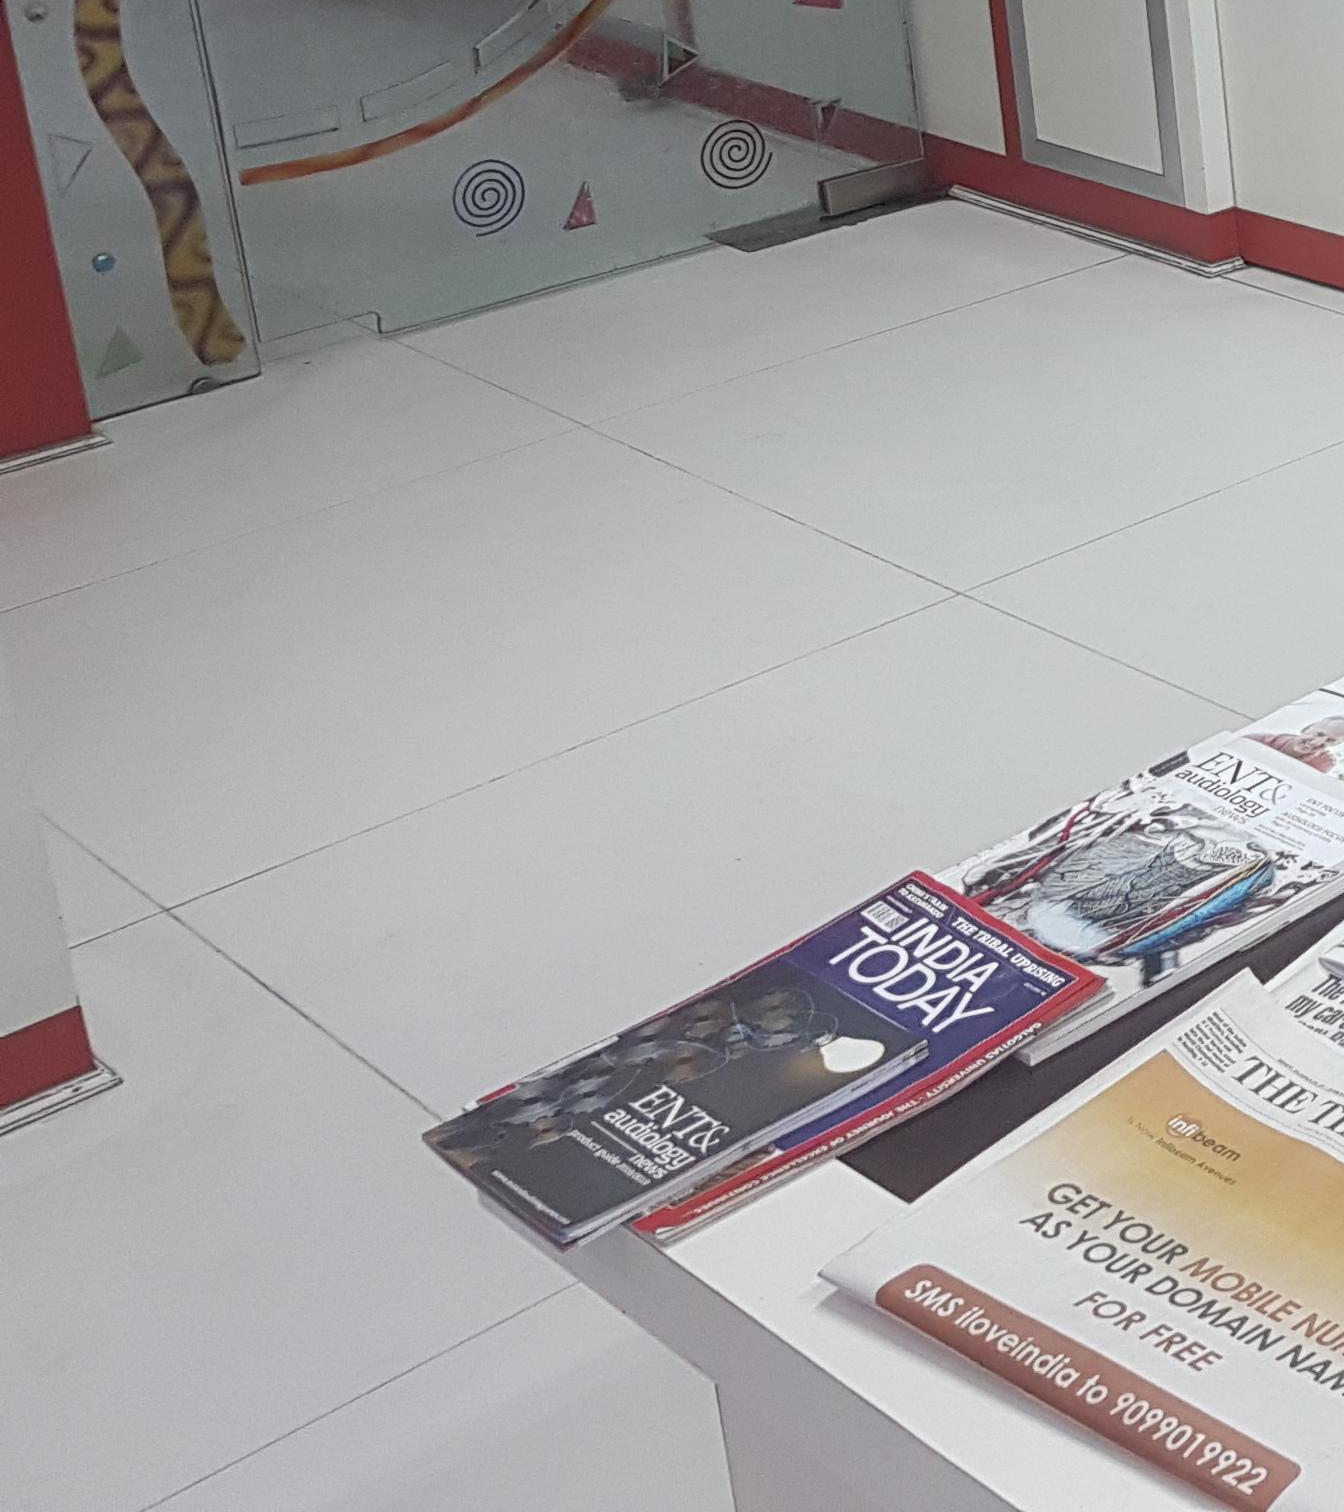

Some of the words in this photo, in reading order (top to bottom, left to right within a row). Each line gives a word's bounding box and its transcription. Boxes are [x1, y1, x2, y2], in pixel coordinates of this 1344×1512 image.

[1175, 769, 1271, 818] audiology
[1193, 751, 1292, 805] ENT&
[829, 927, 994, 1034] TODAY
[884, 919, 1000, 994] INDIA
[950, 917, 978, 936] THE
[972, 930, 1014, 956] TRIBAL
[1009, 953, 1066, 988] UPRISING
[1285, 995, 1322, 1018] my
[922, 1056, 987, 1098] UNIVERSITY
[1232, 1056, 1320, 1114] THE
[596, 1109, 701, 1168] audiology
[625, 1087, 732, 1146] ENT&
[1168, 1115, 1241, 1162] infibeam
[626, 1154, 669, 1178] news
[1197, 1161, 1237, 1186] Avenues
[1018, 1212, 1068, 1246] AS
[1064, 1228, 1154, 1287] YOUR
[1144, 1274, 1286, 1353] DOMAIN
[1048, 1182, 1106, 1225] GET
[1101, 1208, 1190, 1266] YOUR
[1181, 1255, 1305, 1324] MOBILE
[1074, 1290, 1150, 1337] FOR
[1138, 1323, 1222, 1373] FREE
[905, 1279, 965, 1319] SMS
[960, 1300, 1079, 1390] iloveindia
[1079, 1372, 1110, 1404] to
[1109, 1390, 1270, 1497] 9099019922
